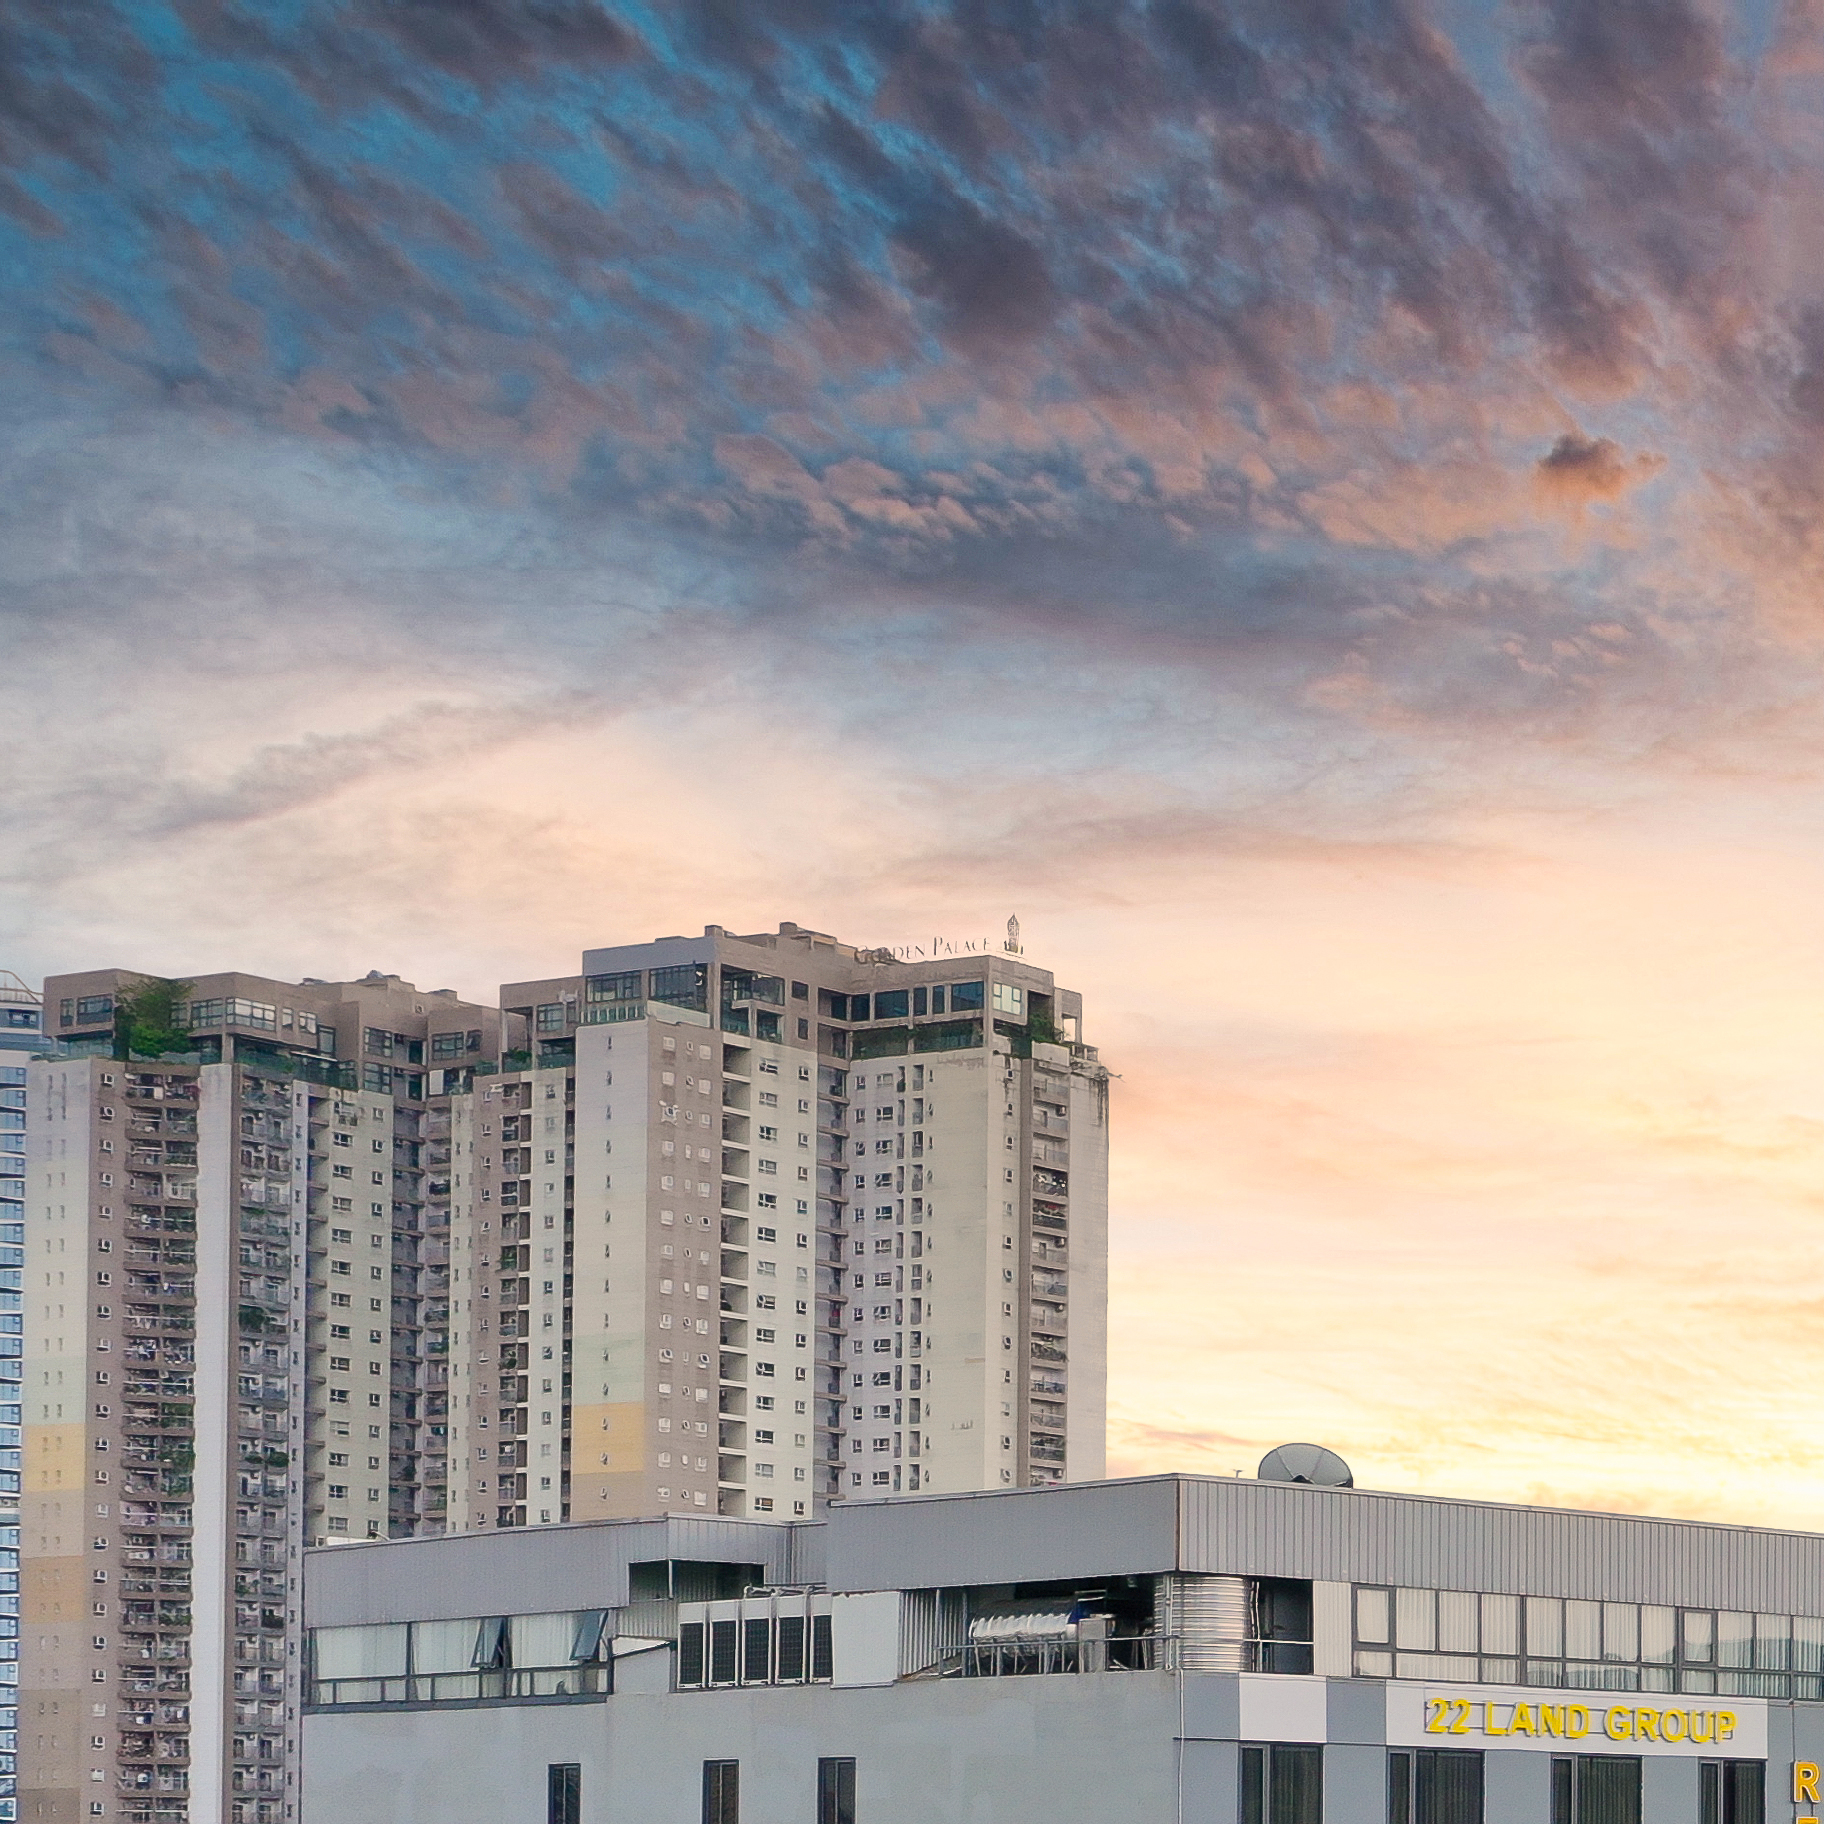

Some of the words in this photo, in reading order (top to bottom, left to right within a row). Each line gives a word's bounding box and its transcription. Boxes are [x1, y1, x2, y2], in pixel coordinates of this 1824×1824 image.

[1425, 1697, 1471, 1734] 22
[1484, 1701, 1591, 1740] LAND
[1604, 1705, 1738, 1744] GROUP
